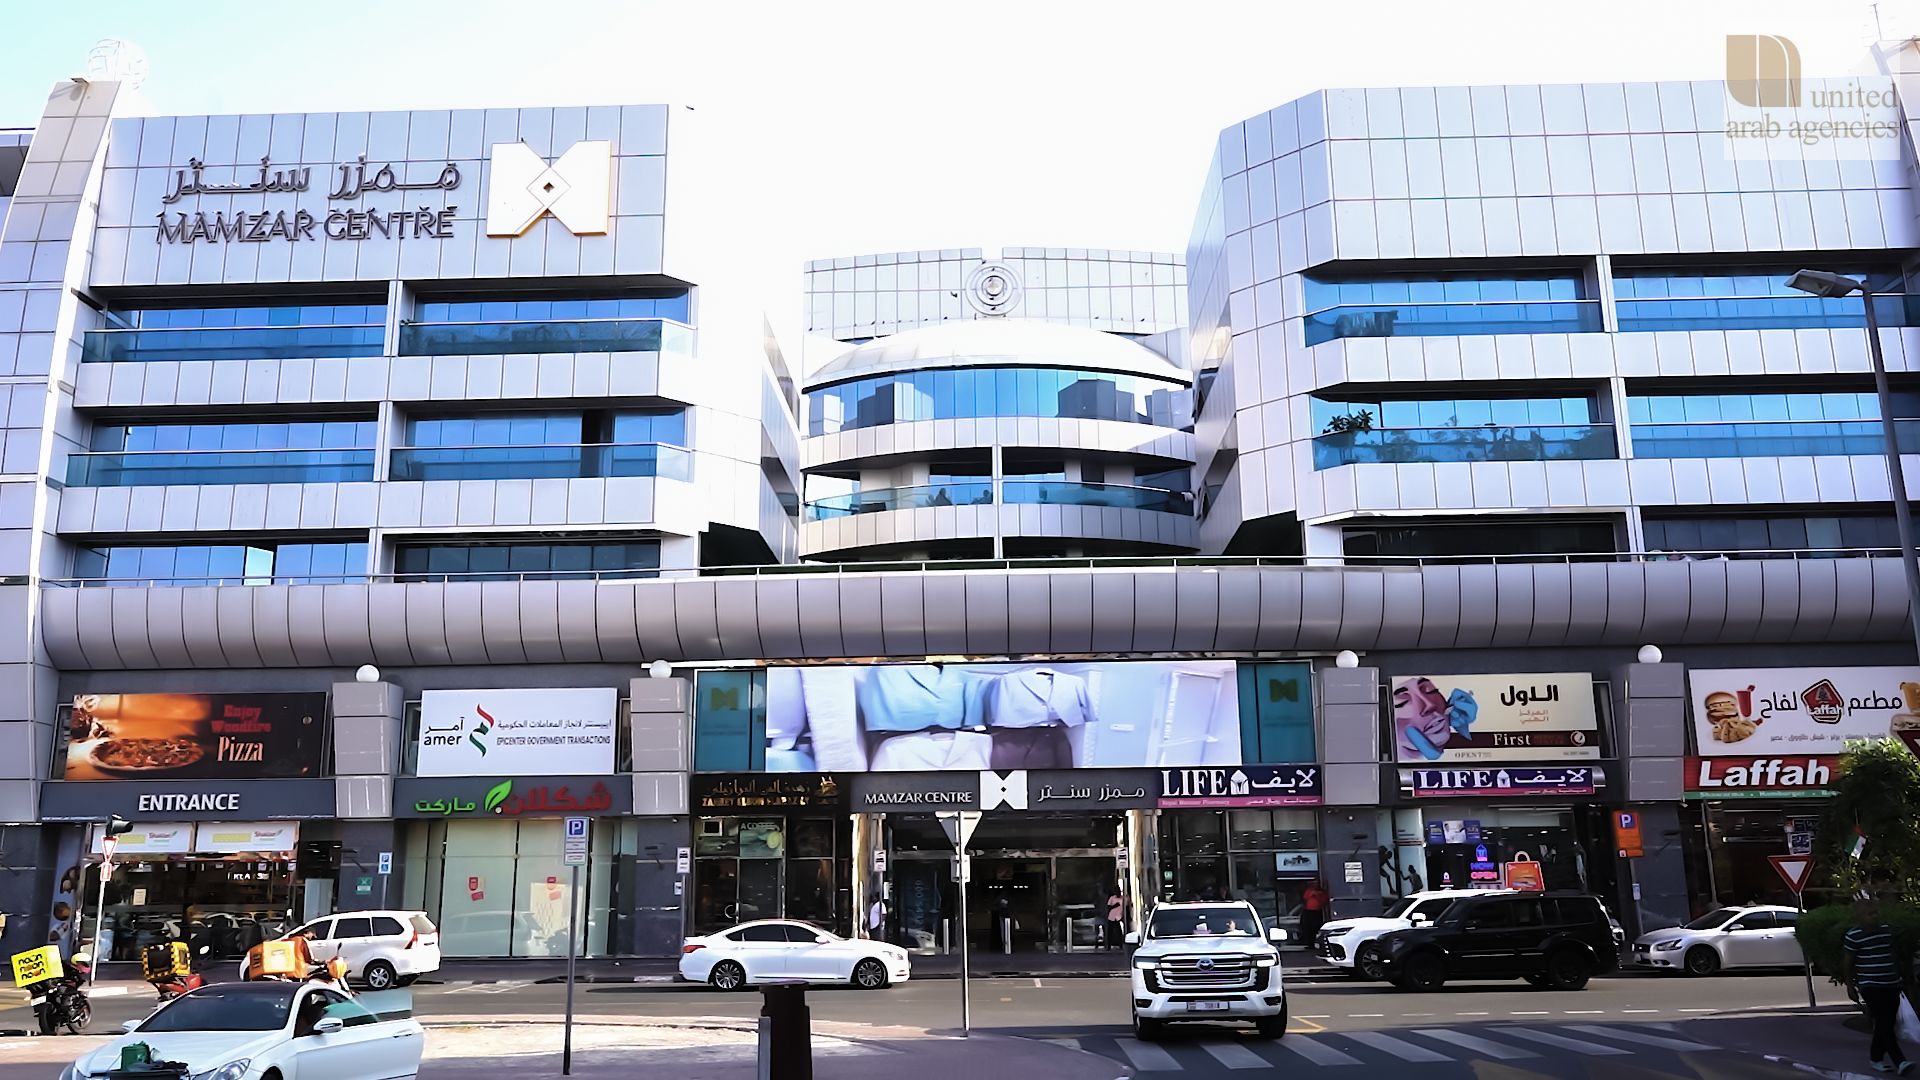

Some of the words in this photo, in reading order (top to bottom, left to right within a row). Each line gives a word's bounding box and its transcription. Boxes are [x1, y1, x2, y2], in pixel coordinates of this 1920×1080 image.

[161, 157, 312, 204] سنتر
[327, 153, 463, 201] ممزر
[156, 208, 317, 244] MAMZAR
[323, 206, 459, 241] CENTRE
[1760, 690, 1798, 719] لفاح
[1806, 703, 1845, 716] Laffah
[1848, 689, 1904, 717] مطعم
[425, 716, 465, 734] آمر
[217, 735, 264, 763] Pizza
[423, 734, 463, 747] amer
[496, 736, 526, 746] EPICENTER
[527, 735, 566, 745] GOVERNMENT
[567, 735, 611, 745] TRANSACTIONS
[1493, 733, 1532, 746] First
[1251, 768, 1317, 794] لايف
[1418, 770, 1493, 789] LIFE
[1514, 768, 1588, 787] لايف
[1698, 758, 1831, 787] Laffah
[1098, 783, 1146, 801] ممزر
[1161, 769, 1228, 797] LIFE
[138, 793, 241, 812] ENTRANCE
[864, 793, 923, 804] MAMZAR
[924, 791, 973, 804] CENTRE
[1037, 784, 1092, 803] سنتر
[415, 796, 476, 816] ماركت
[571, 821, 582, 835] P
[1620, 813, 1632, 828] P
